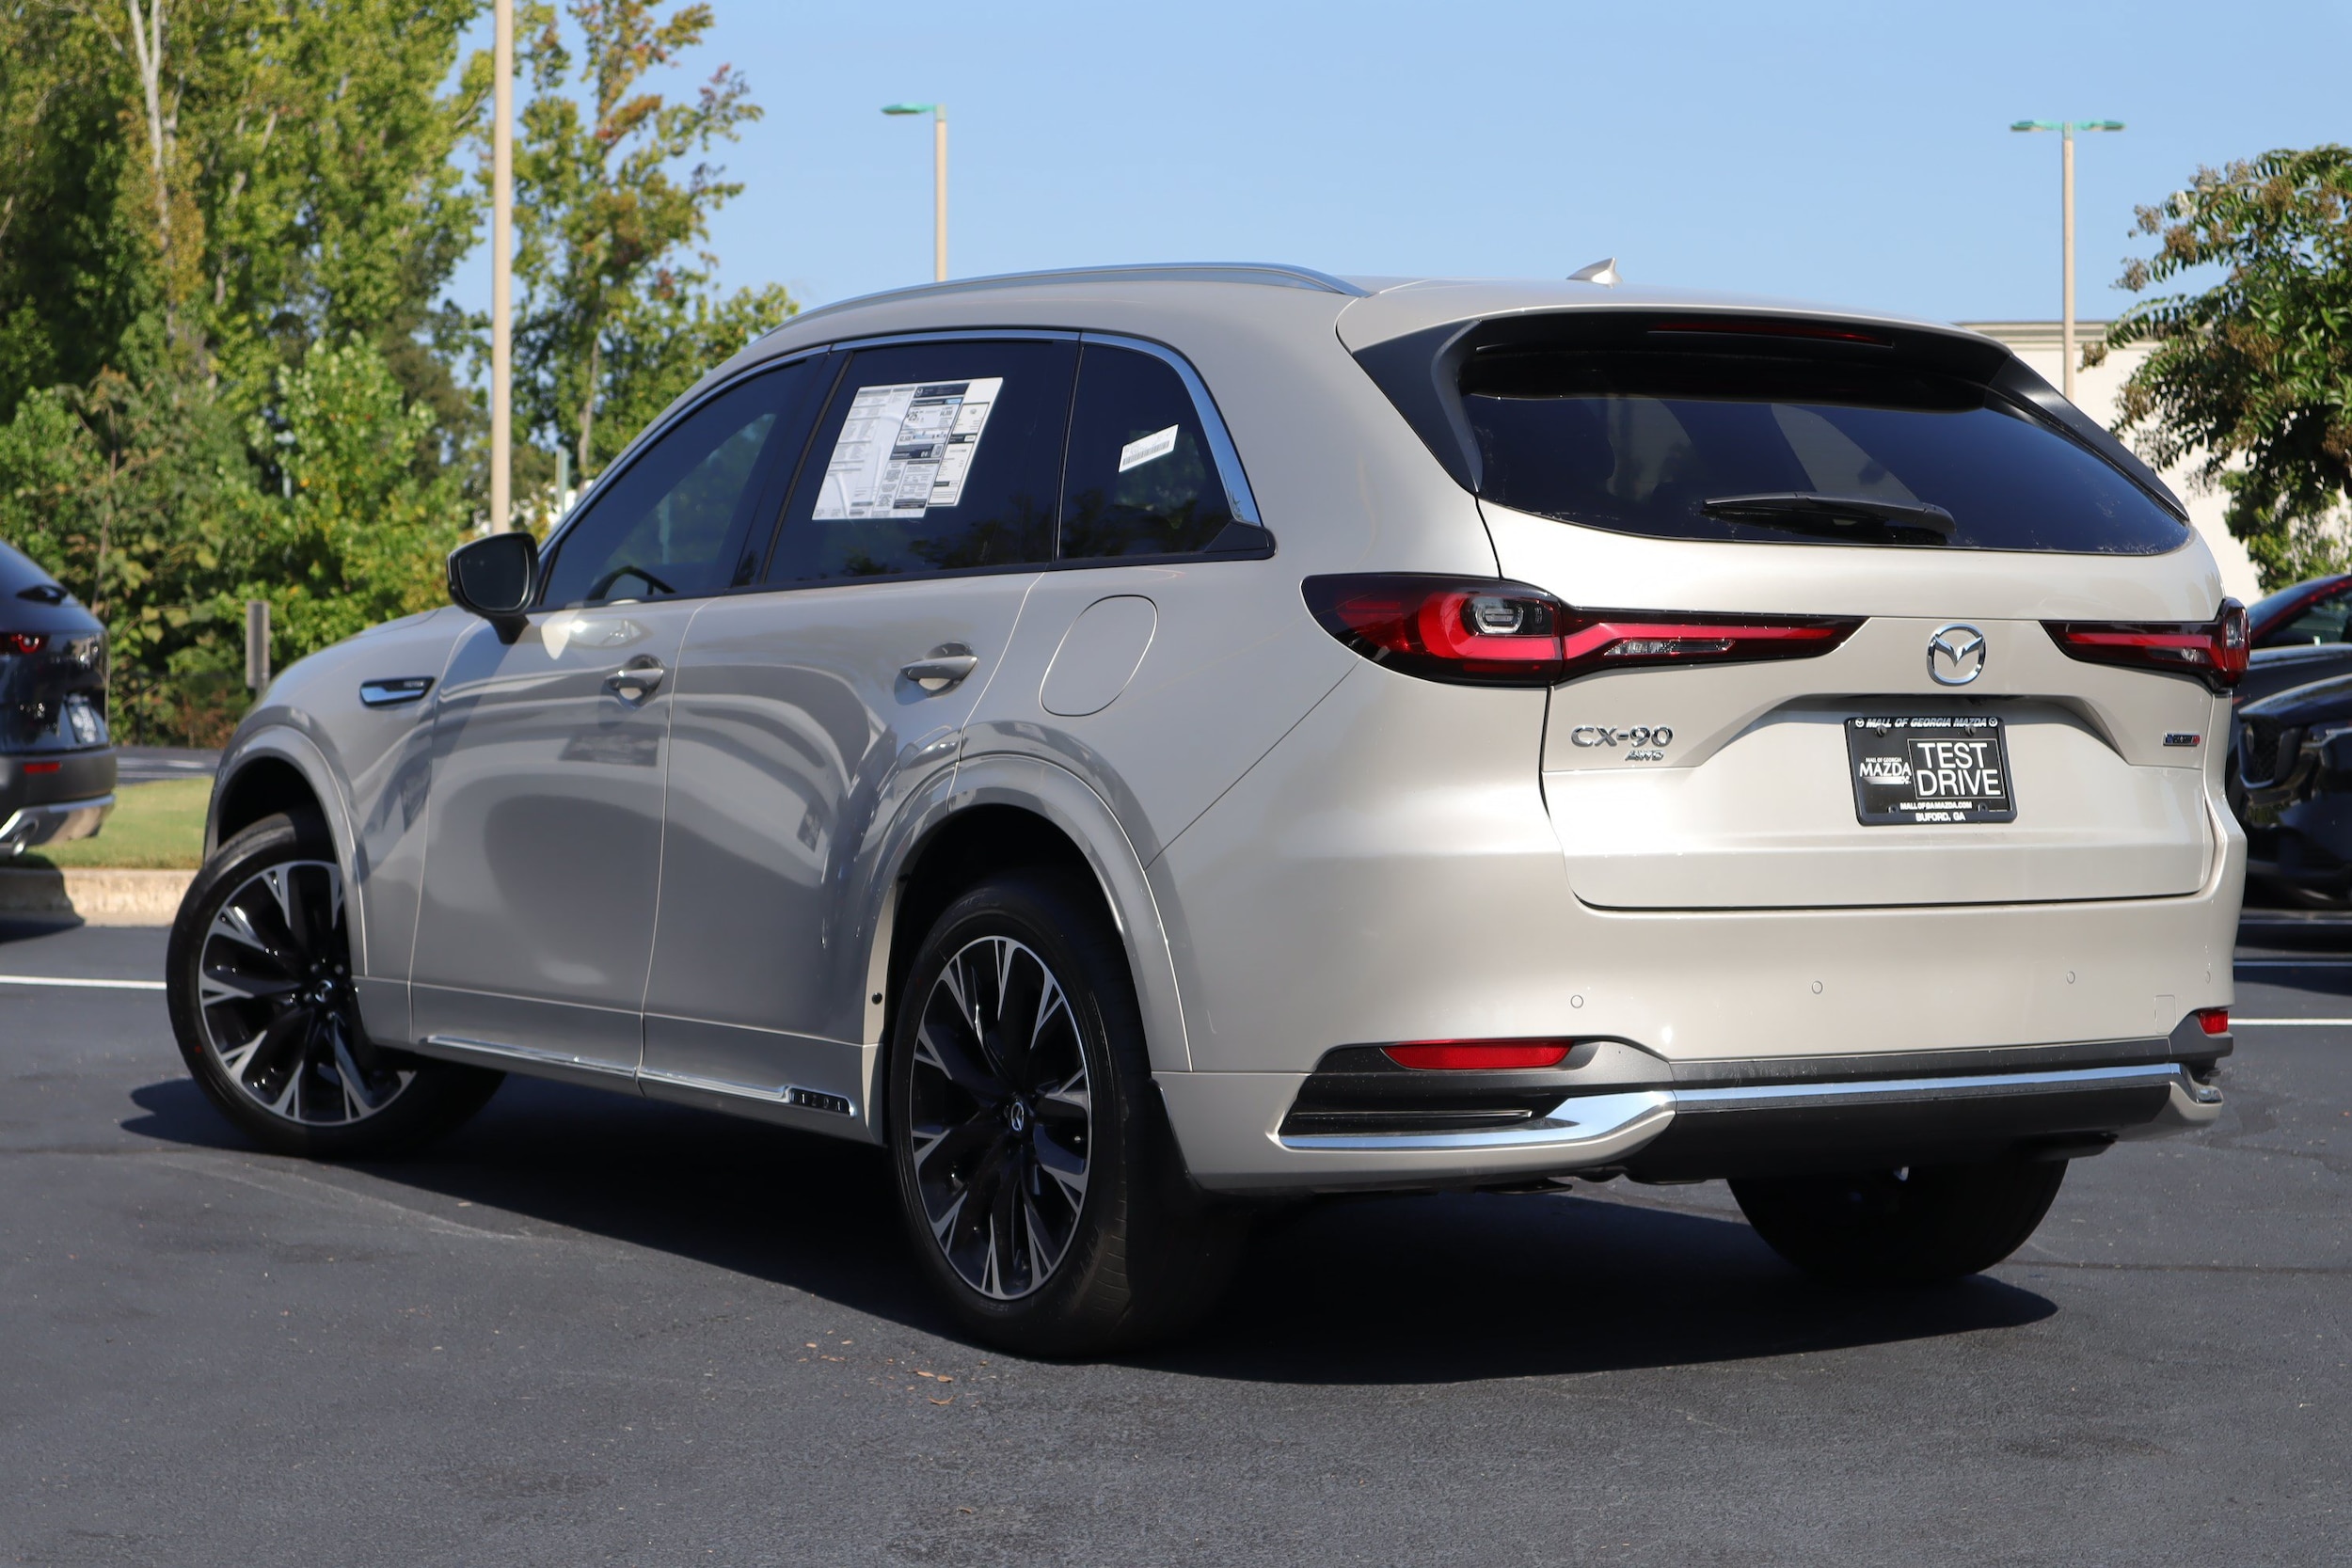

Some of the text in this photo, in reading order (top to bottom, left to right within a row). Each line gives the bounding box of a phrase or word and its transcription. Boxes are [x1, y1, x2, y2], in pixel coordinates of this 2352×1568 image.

[1867, 718, 1987, 728] MALL OF GEORGIA MAZDA
[1570, 724, 1674, 748] CX-90
[1625, 750, 1664, 762] AWD
[1917, 742, 1987, 769] TEST
[1860, 762, 1912, 777] MAZDA
[1916, 769, 2001, 797] DRIVE
[1915, 812, 1966, 822] BUFORD, GA
